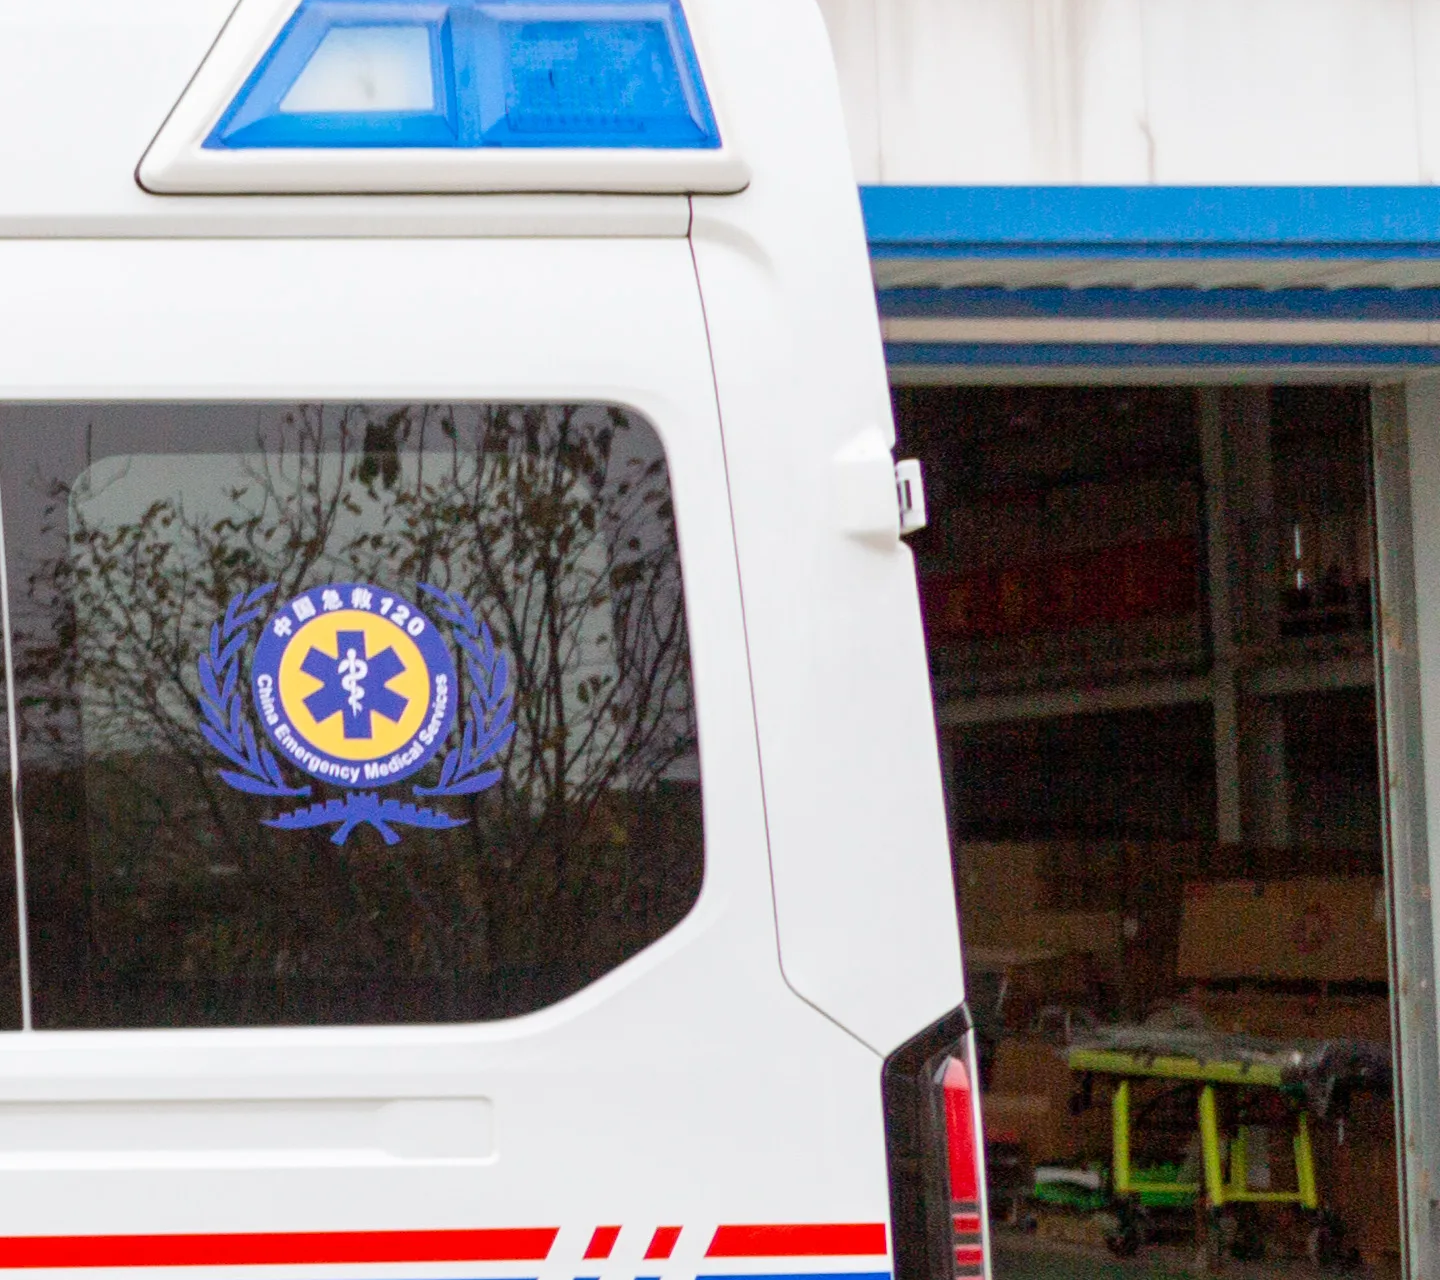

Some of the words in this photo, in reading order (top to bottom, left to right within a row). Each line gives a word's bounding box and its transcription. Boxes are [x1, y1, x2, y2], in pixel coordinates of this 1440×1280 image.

[273, 587, 426, 637] 中国急救120
[257, 673, 279, 726] China
[274, 723, 361, 784] Emergency
[364, 740, 425, 780] Medical
[418, 673, 448, 746] Services
